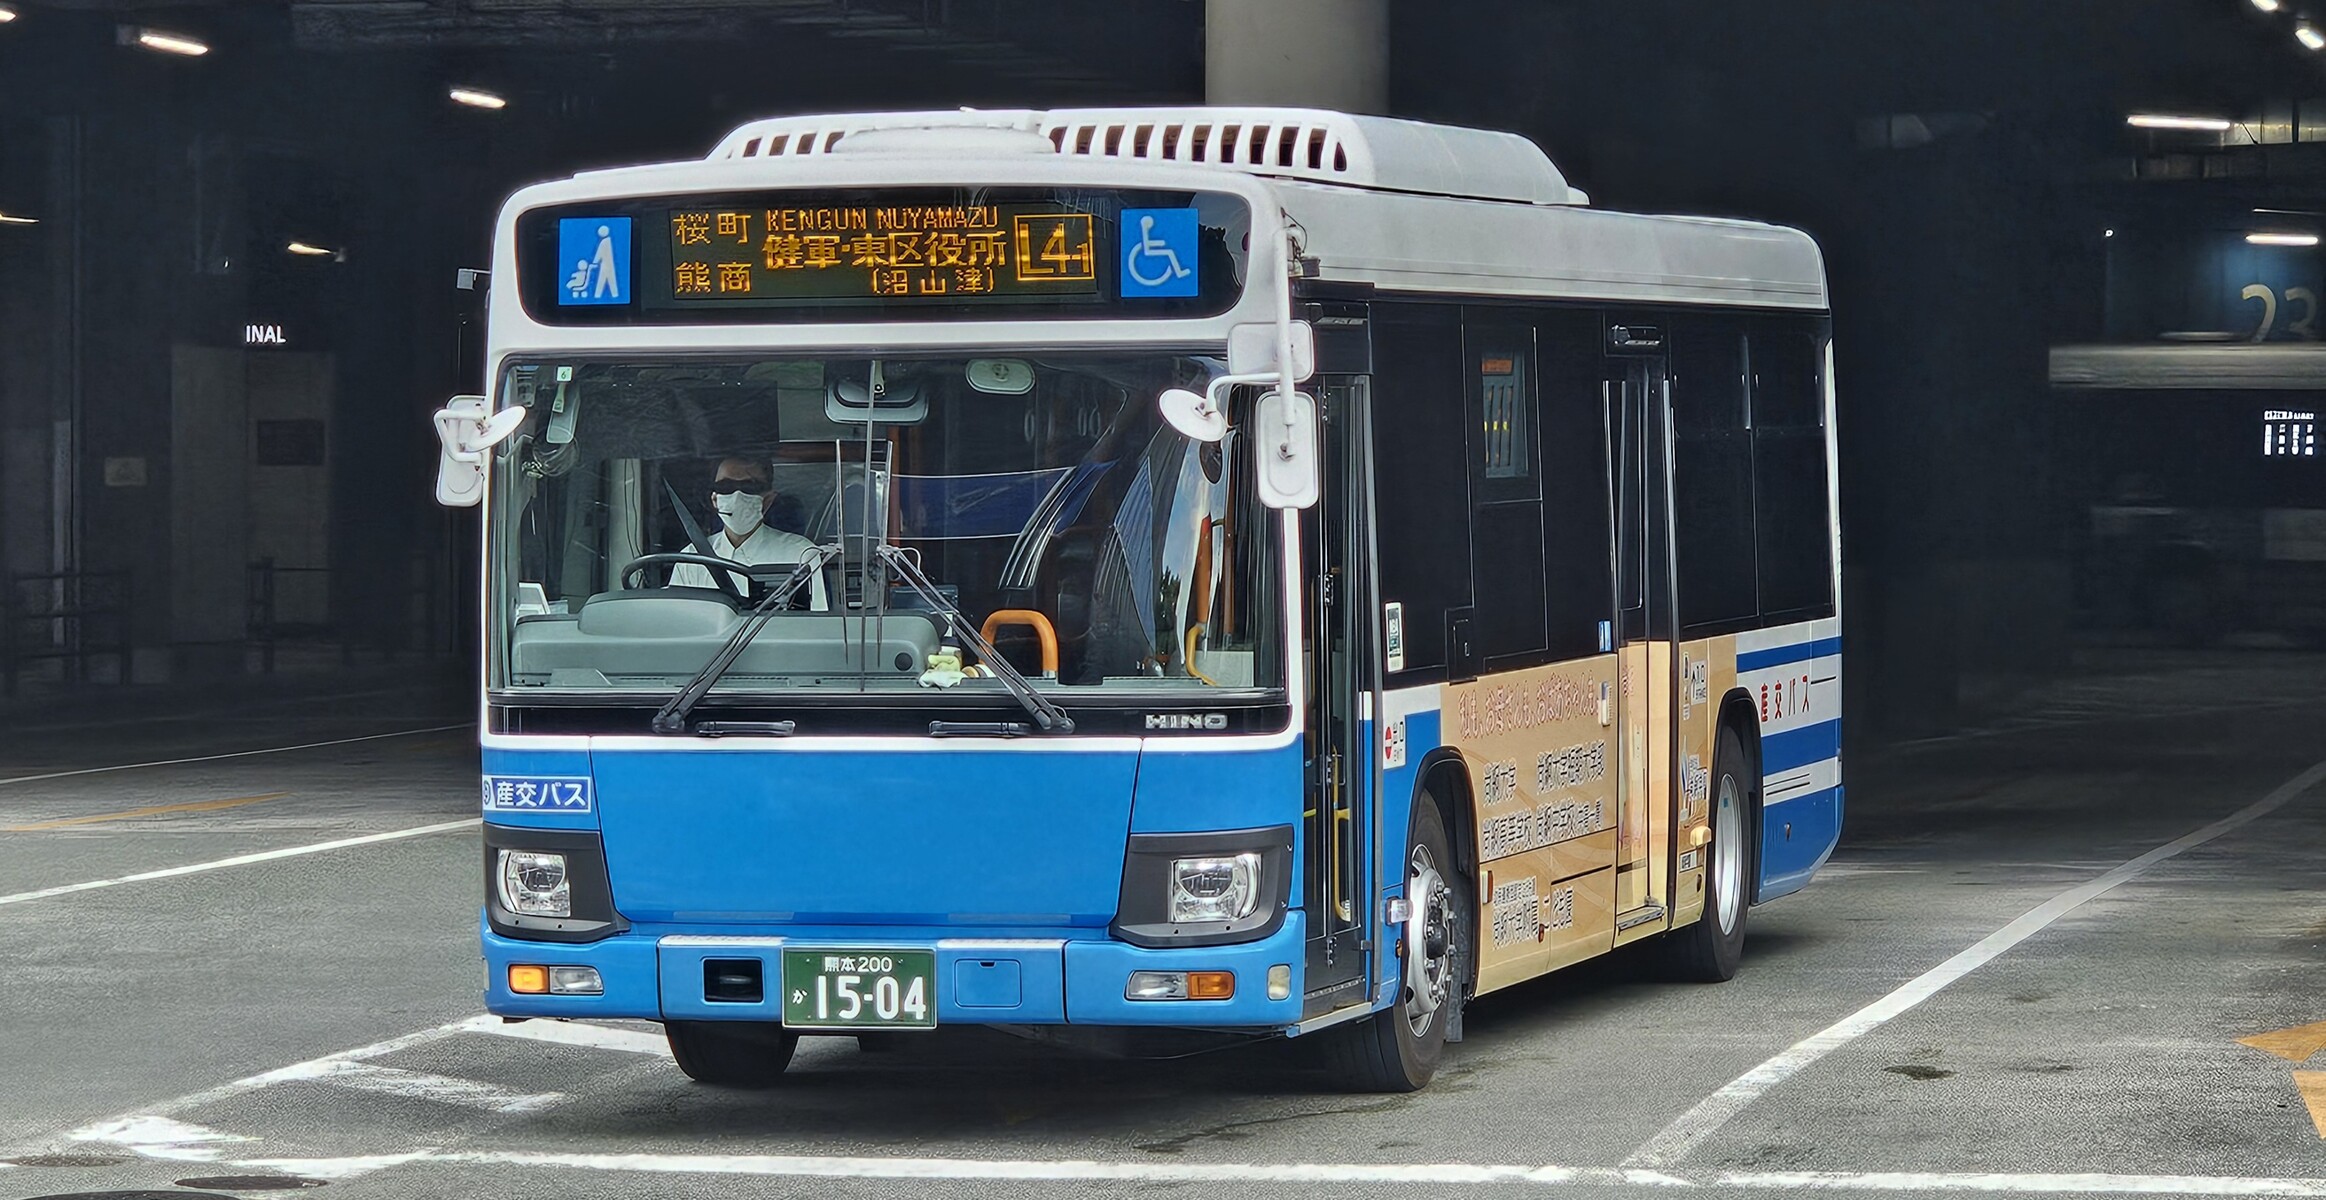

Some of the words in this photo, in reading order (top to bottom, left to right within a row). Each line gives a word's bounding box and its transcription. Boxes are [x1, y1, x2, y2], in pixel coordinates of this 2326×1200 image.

[673, 212, 752, 245] 桜町
[767, 209, 866, 231] KENGUN
[877, 206, 998, 229] NUYAMAZU
[675, 261, 752, 293] 熊商
[246, 324, 287, 344] INAL
[1761, 675, 1810, 722] 産交バス
[1146, 714, 1228, 729] HINO
[496, 781, 587, 807] 産交バス
[824, 956, 892, 973] 熊本200
[792, 989, 808, 1004] か
[817, 976, 927, 1020] 15-04
